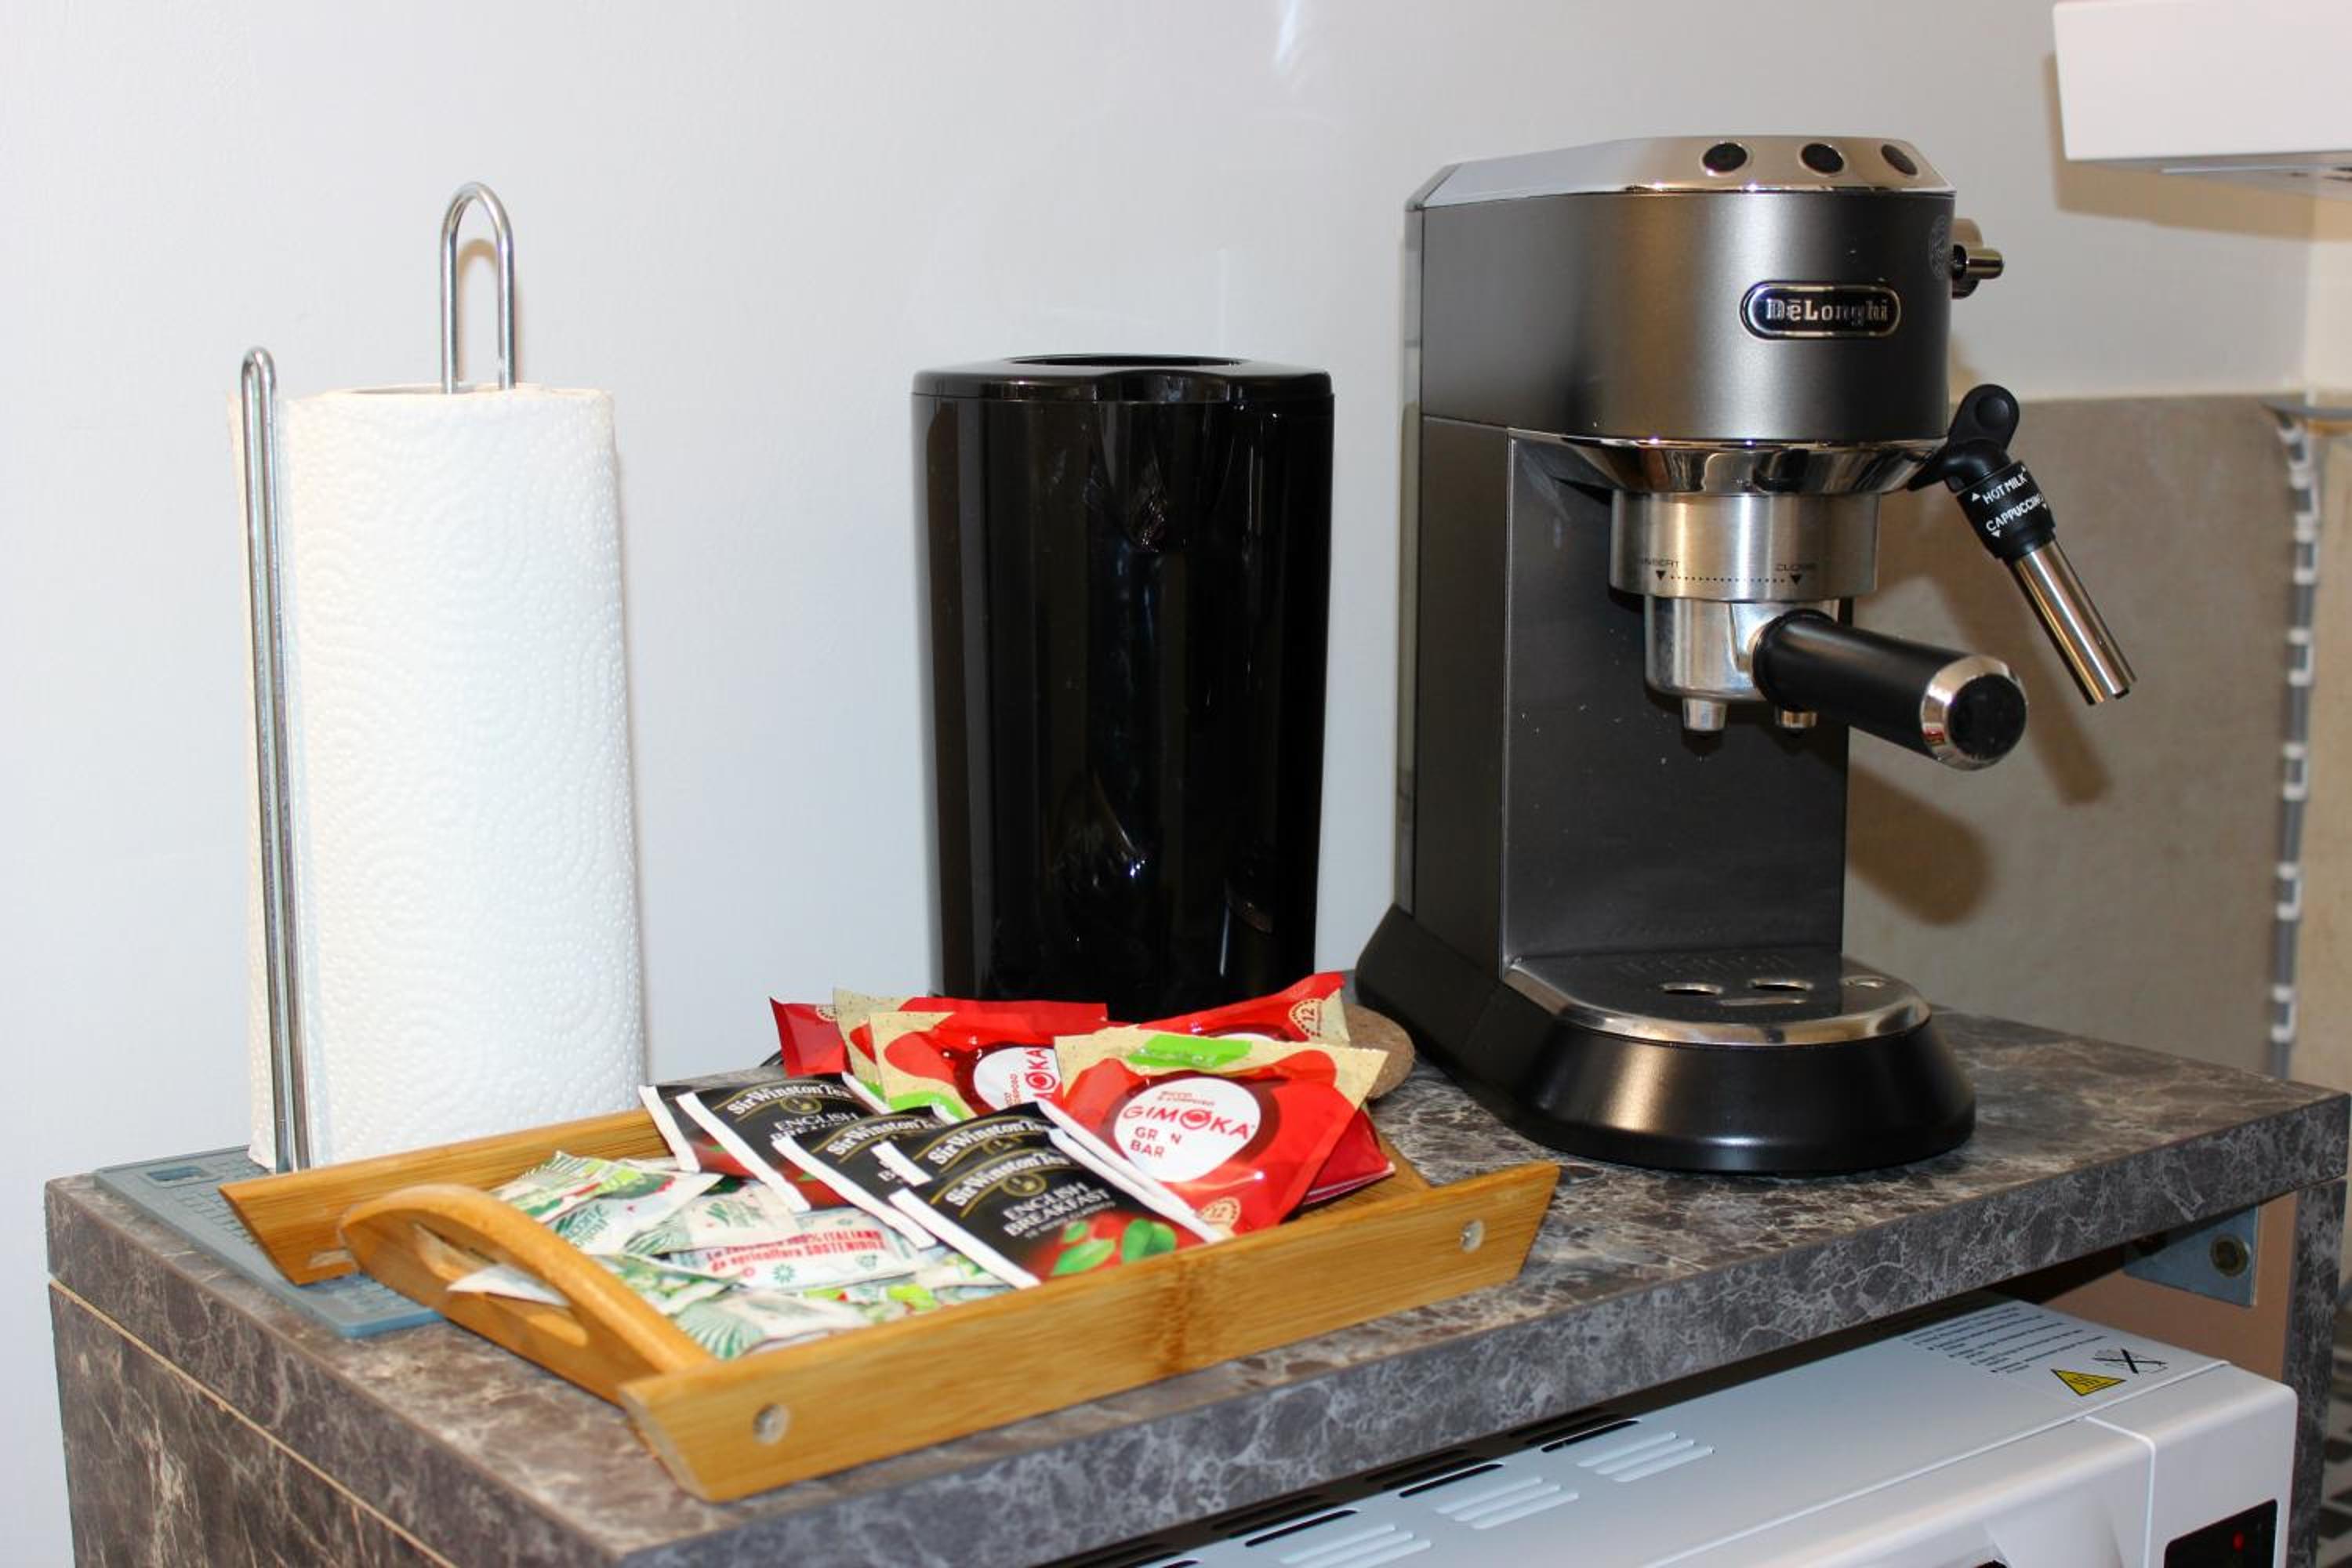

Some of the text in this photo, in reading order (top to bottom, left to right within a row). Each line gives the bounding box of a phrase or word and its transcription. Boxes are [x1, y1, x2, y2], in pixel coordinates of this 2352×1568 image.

[1982, 473, 2028, 505] HOT MILK
[1301, 1008, 1315, 1022] 12
[727, 1098, 756, 1116] Sir
[746, 1084, 821, 1104] Winston
[773, 1112, 860, 1131] ENGLISH
[826, 1137, 857, 1156] Sir
[844, 1120, 916, 1139] Winston
[1123, 1106, 1249, 1140] GIMOKA
[927, 1145, 960, 1165] Sir
[946, 1122, 1022, 1147] Winston
[1130, 1139, 1165, 1158] BAR
[945, 1186, 978, 1207] Sir
[962, 1156, 1037, 1189] Winston
[1003, 1181, 1089, 1221] ENGLISH
[1004, 1189, 1110, 1236] BREAKFAST
